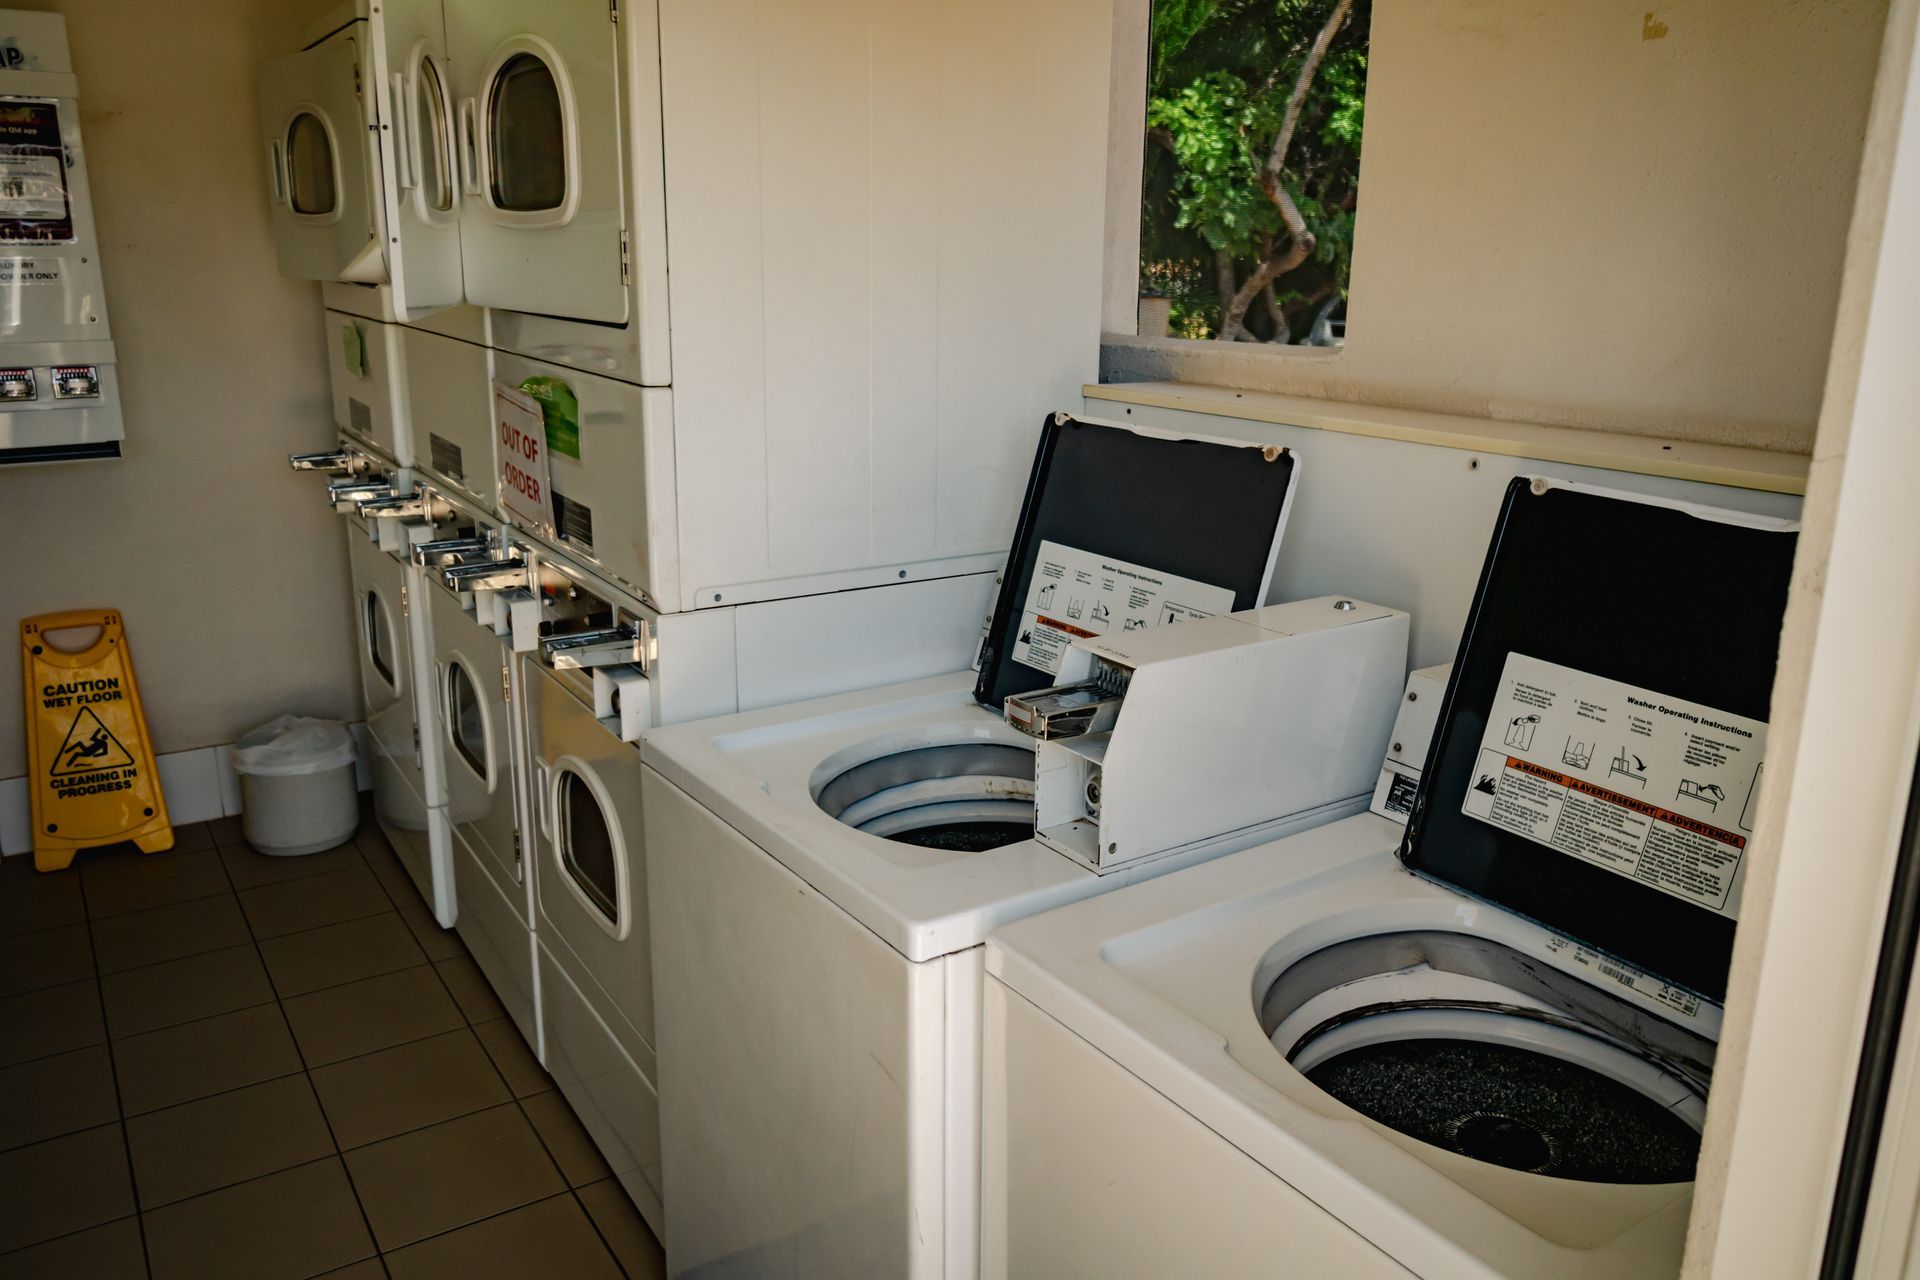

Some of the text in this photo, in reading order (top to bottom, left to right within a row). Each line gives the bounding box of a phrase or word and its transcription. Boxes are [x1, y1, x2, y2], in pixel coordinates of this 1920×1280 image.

[36, 272, 58, 280] ONLY
[502, 422, 538, 463] OUT OF
[505, 462, 541, 504] ORDER
[1117, 568, 1137, 580] Operating
[1138, 574, 1163, 585] Instructions
[43, 678, 119, 697] CAUTION
[43, 691, 122, 708] WET FLOOR
[1626, 696, 1753, 738] Washer Operating Instructions
[50, 768, 137, 789] CLEANING IN
[1522, 763, 1563, 782] WARNING
[58, 780, 132, 799] PROGRESS
[1579, 783, 1656, 815] AVERTISSEMENT
[1669, 814, 1740, 844] ADVERTENCIA
